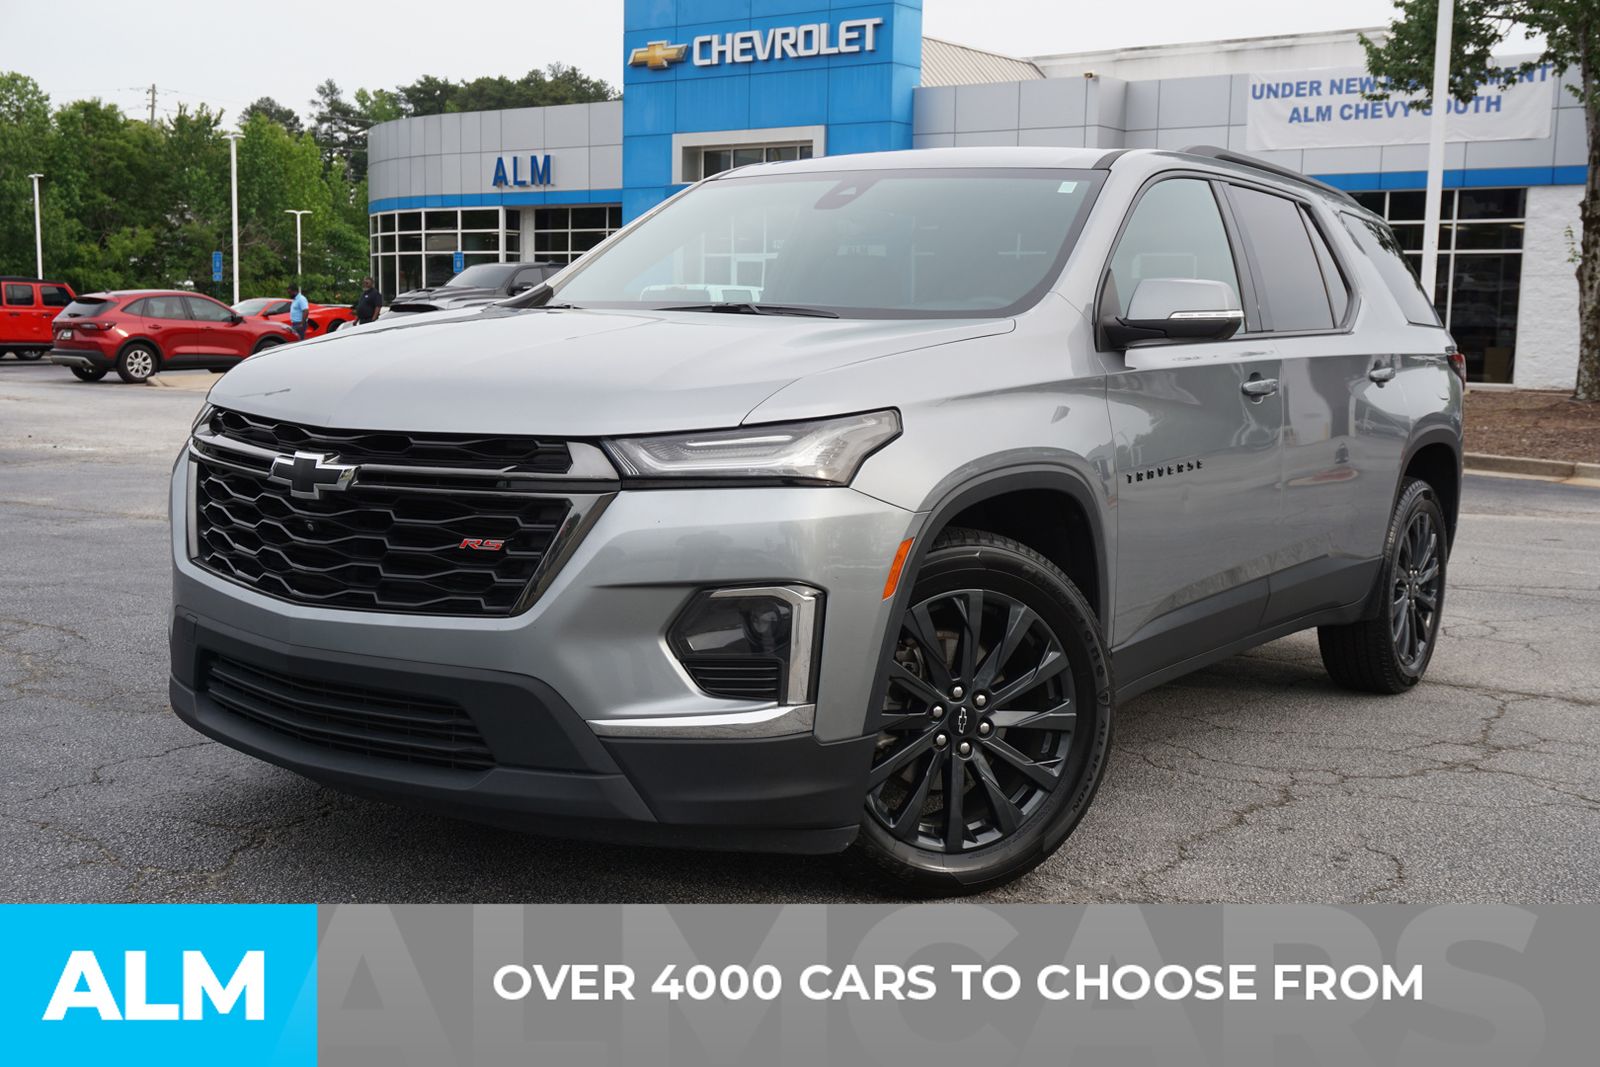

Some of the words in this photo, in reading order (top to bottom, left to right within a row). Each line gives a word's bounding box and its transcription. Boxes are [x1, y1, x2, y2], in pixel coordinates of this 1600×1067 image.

[692, 17, 884, 67] CHEVROLET
[1251, 79, 1322, 100] UNDER
[1329, 75, 1377, 96] NEW
[1288, 105, 1332, 124] ALM
[1339, 101, 1410, 121] CHEVY
[492, 154, 555, 187] ALM
[1126, 460, 1203, 484] TRAVERSE
[459, 538, 505, 551] RS
